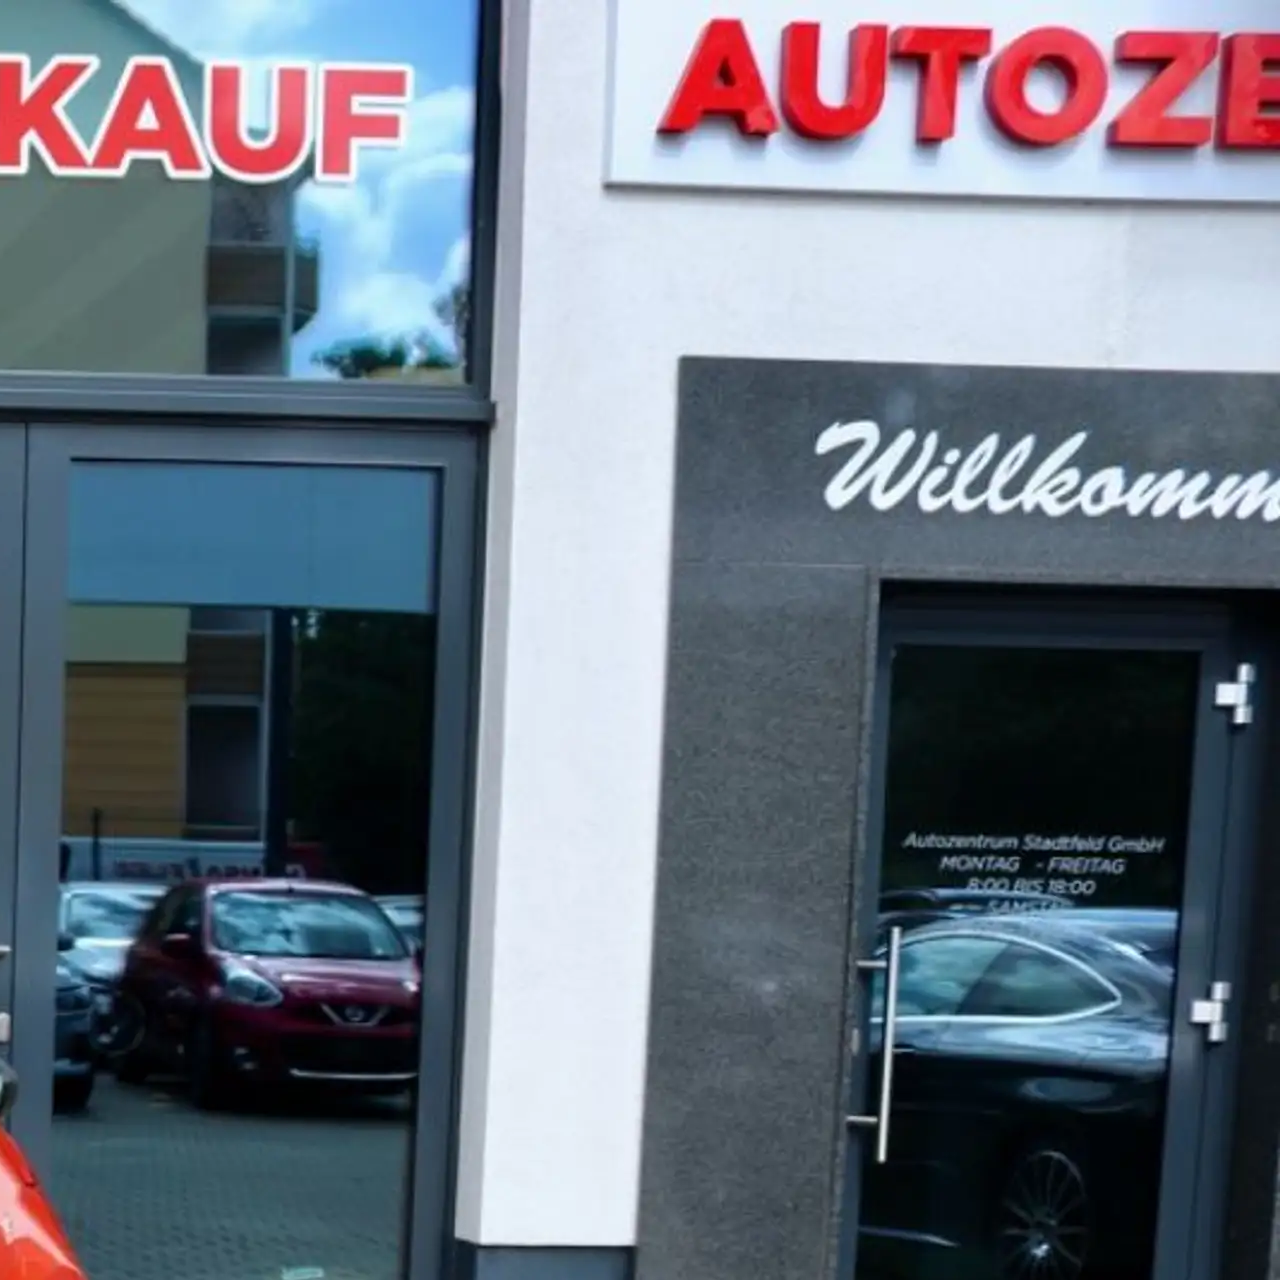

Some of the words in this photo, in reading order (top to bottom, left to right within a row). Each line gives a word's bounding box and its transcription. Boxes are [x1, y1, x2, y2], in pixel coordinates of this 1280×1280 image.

[656, 17, 1280, 150] AUTOZE
[814, 419, 1280, 523] Willkomm
[902, 831, 1019, 849] Autozentrum
[940, 855, 1021, 872] MONTAG
[1047, 856, 1128, 875] FREITAG
